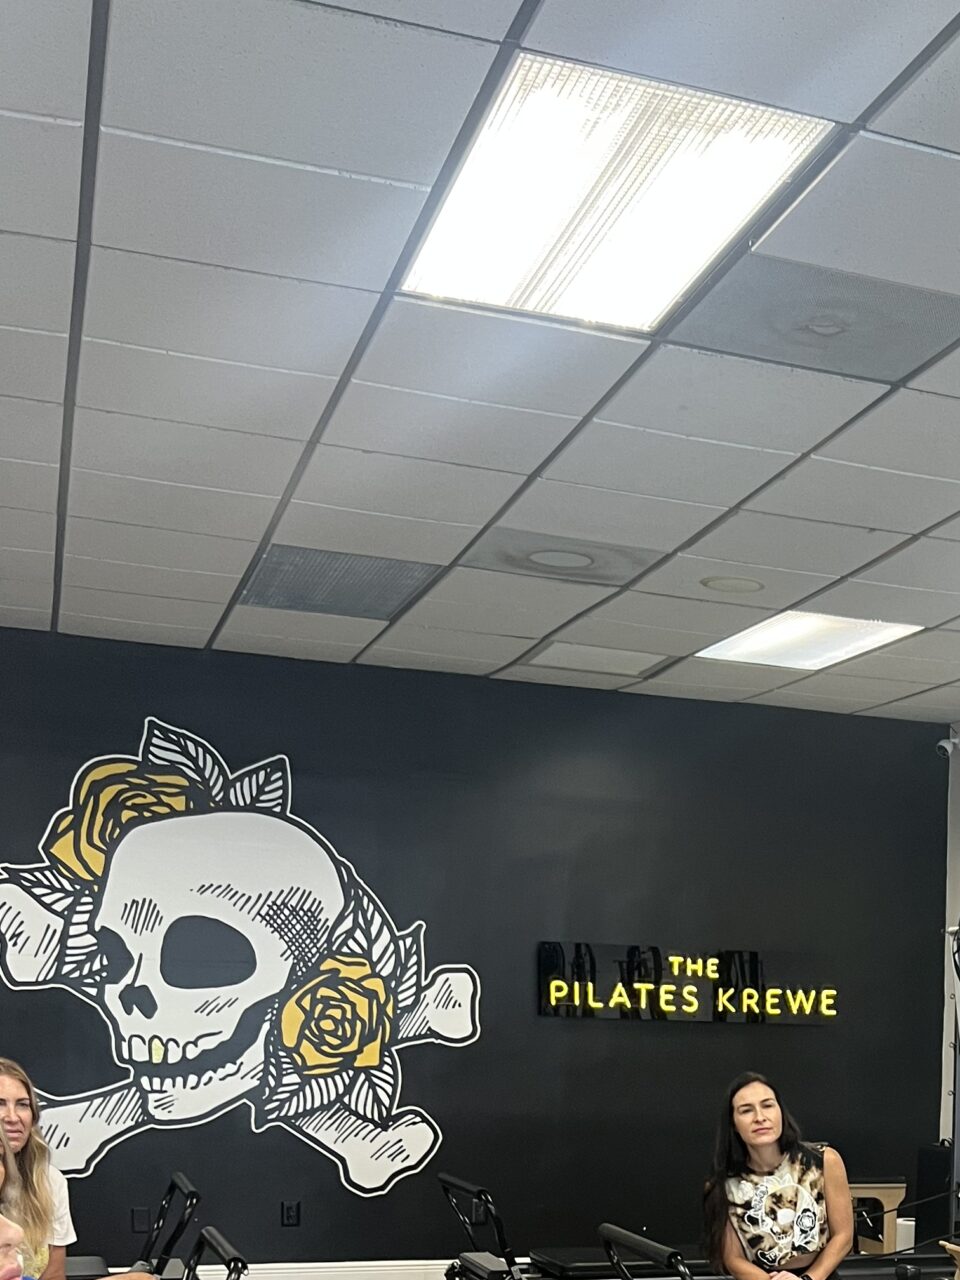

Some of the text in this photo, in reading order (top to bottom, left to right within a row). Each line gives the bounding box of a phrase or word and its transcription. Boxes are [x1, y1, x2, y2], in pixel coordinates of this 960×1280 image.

[668, 956, 720, 979] THE
[549, 980, 838, 1016] PILATES KREWE
